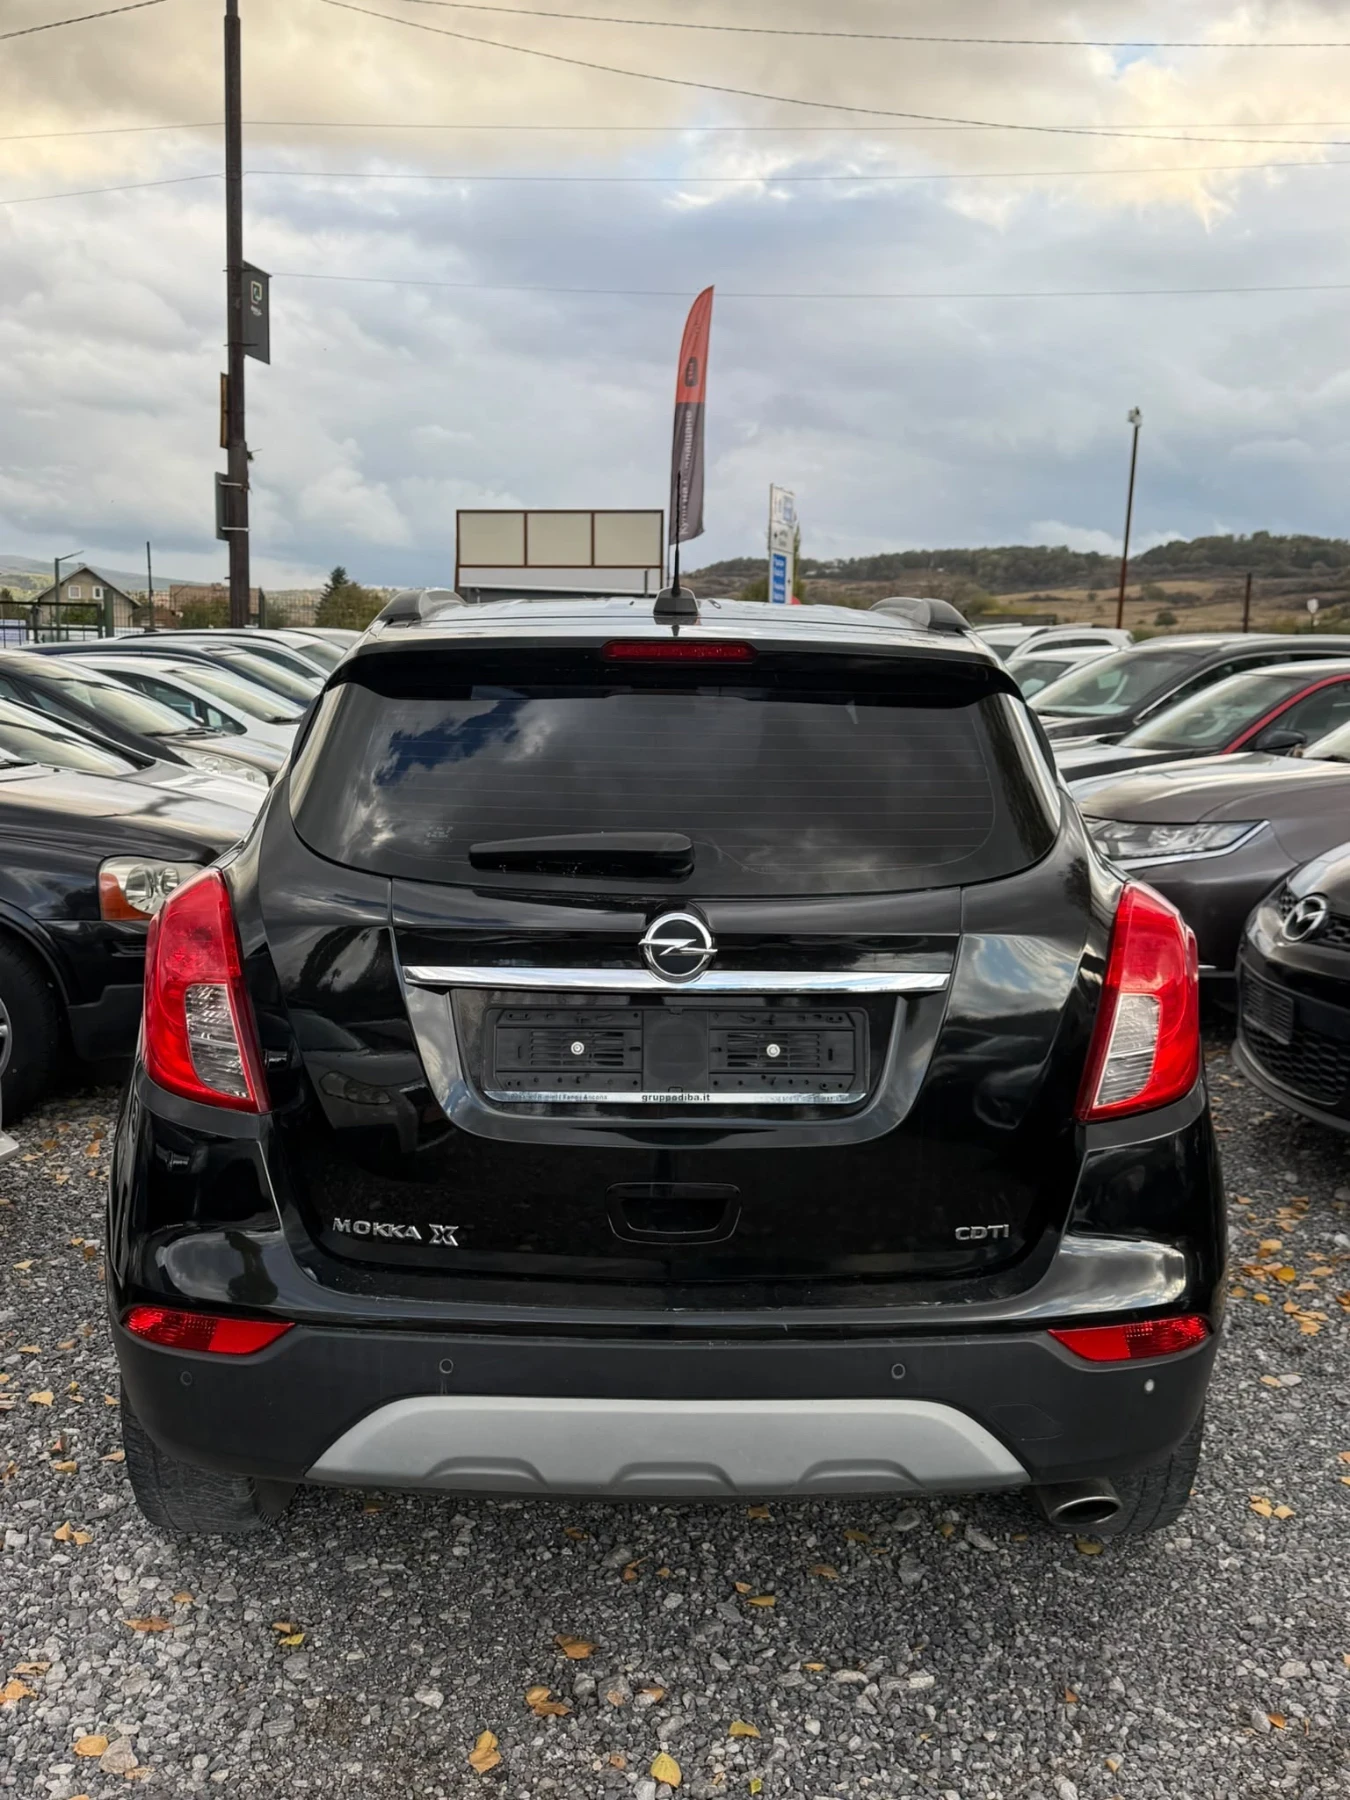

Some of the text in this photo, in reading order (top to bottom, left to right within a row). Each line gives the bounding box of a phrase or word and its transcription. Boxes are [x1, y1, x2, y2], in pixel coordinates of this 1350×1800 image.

[641, 1093, 710, 1103] gruppodiba.it
[332, 1217, 459, 1246] MOKKA X
[955, 1224, 1009, 1240] CDTI
